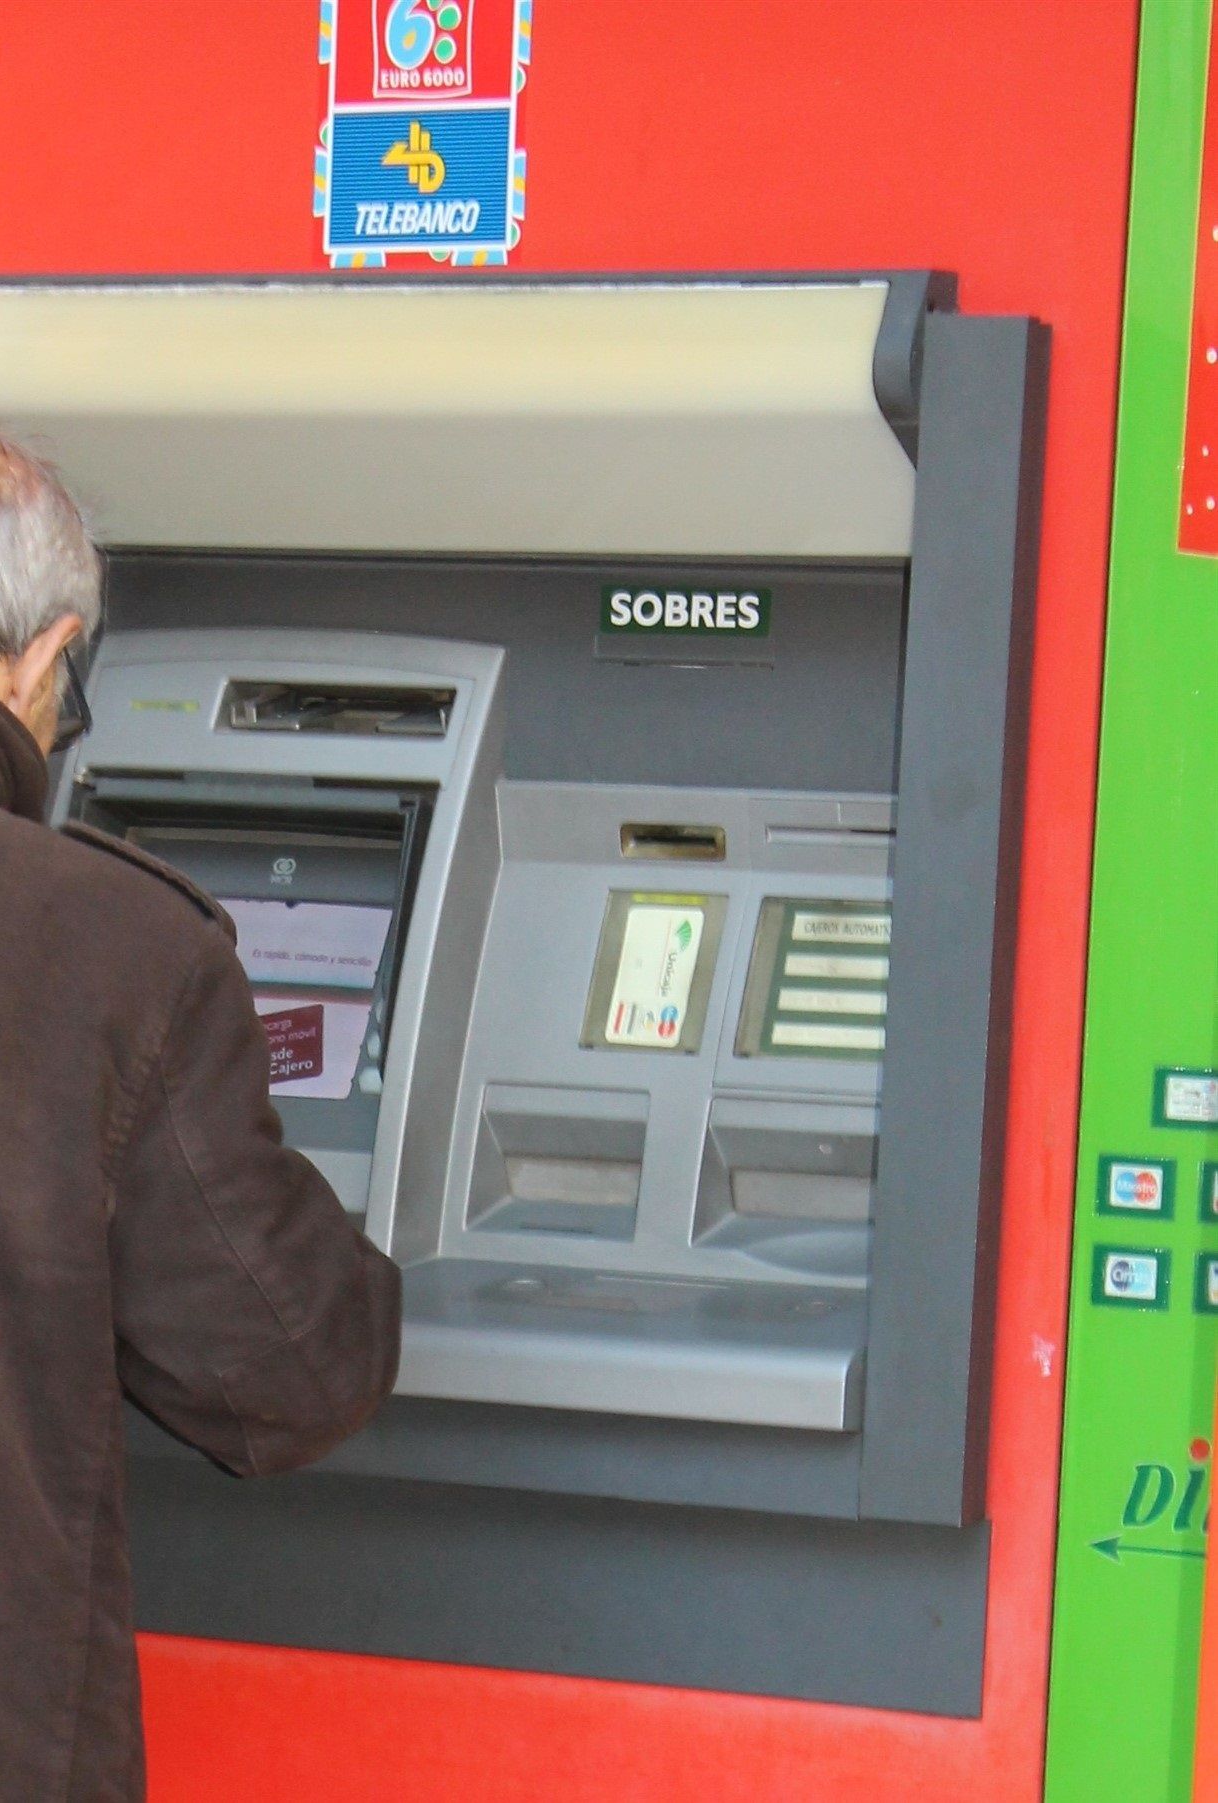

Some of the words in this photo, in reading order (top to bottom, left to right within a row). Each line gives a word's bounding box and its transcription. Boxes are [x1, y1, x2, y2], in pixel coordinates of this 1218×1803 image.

[380, 69, 421, 89] EURO
[422, 67, 465, 88] 6000
[354, 199, 481, 236] TELEBANCO
[610, 591, 761, 629] SOBRES
[266, 1018, 292, 1032] carga
[270, 1046, 294, 1061] sde
[269, 1060, 314, 1076] Cajero
[1122, 1437, 1210, 1534] Di
